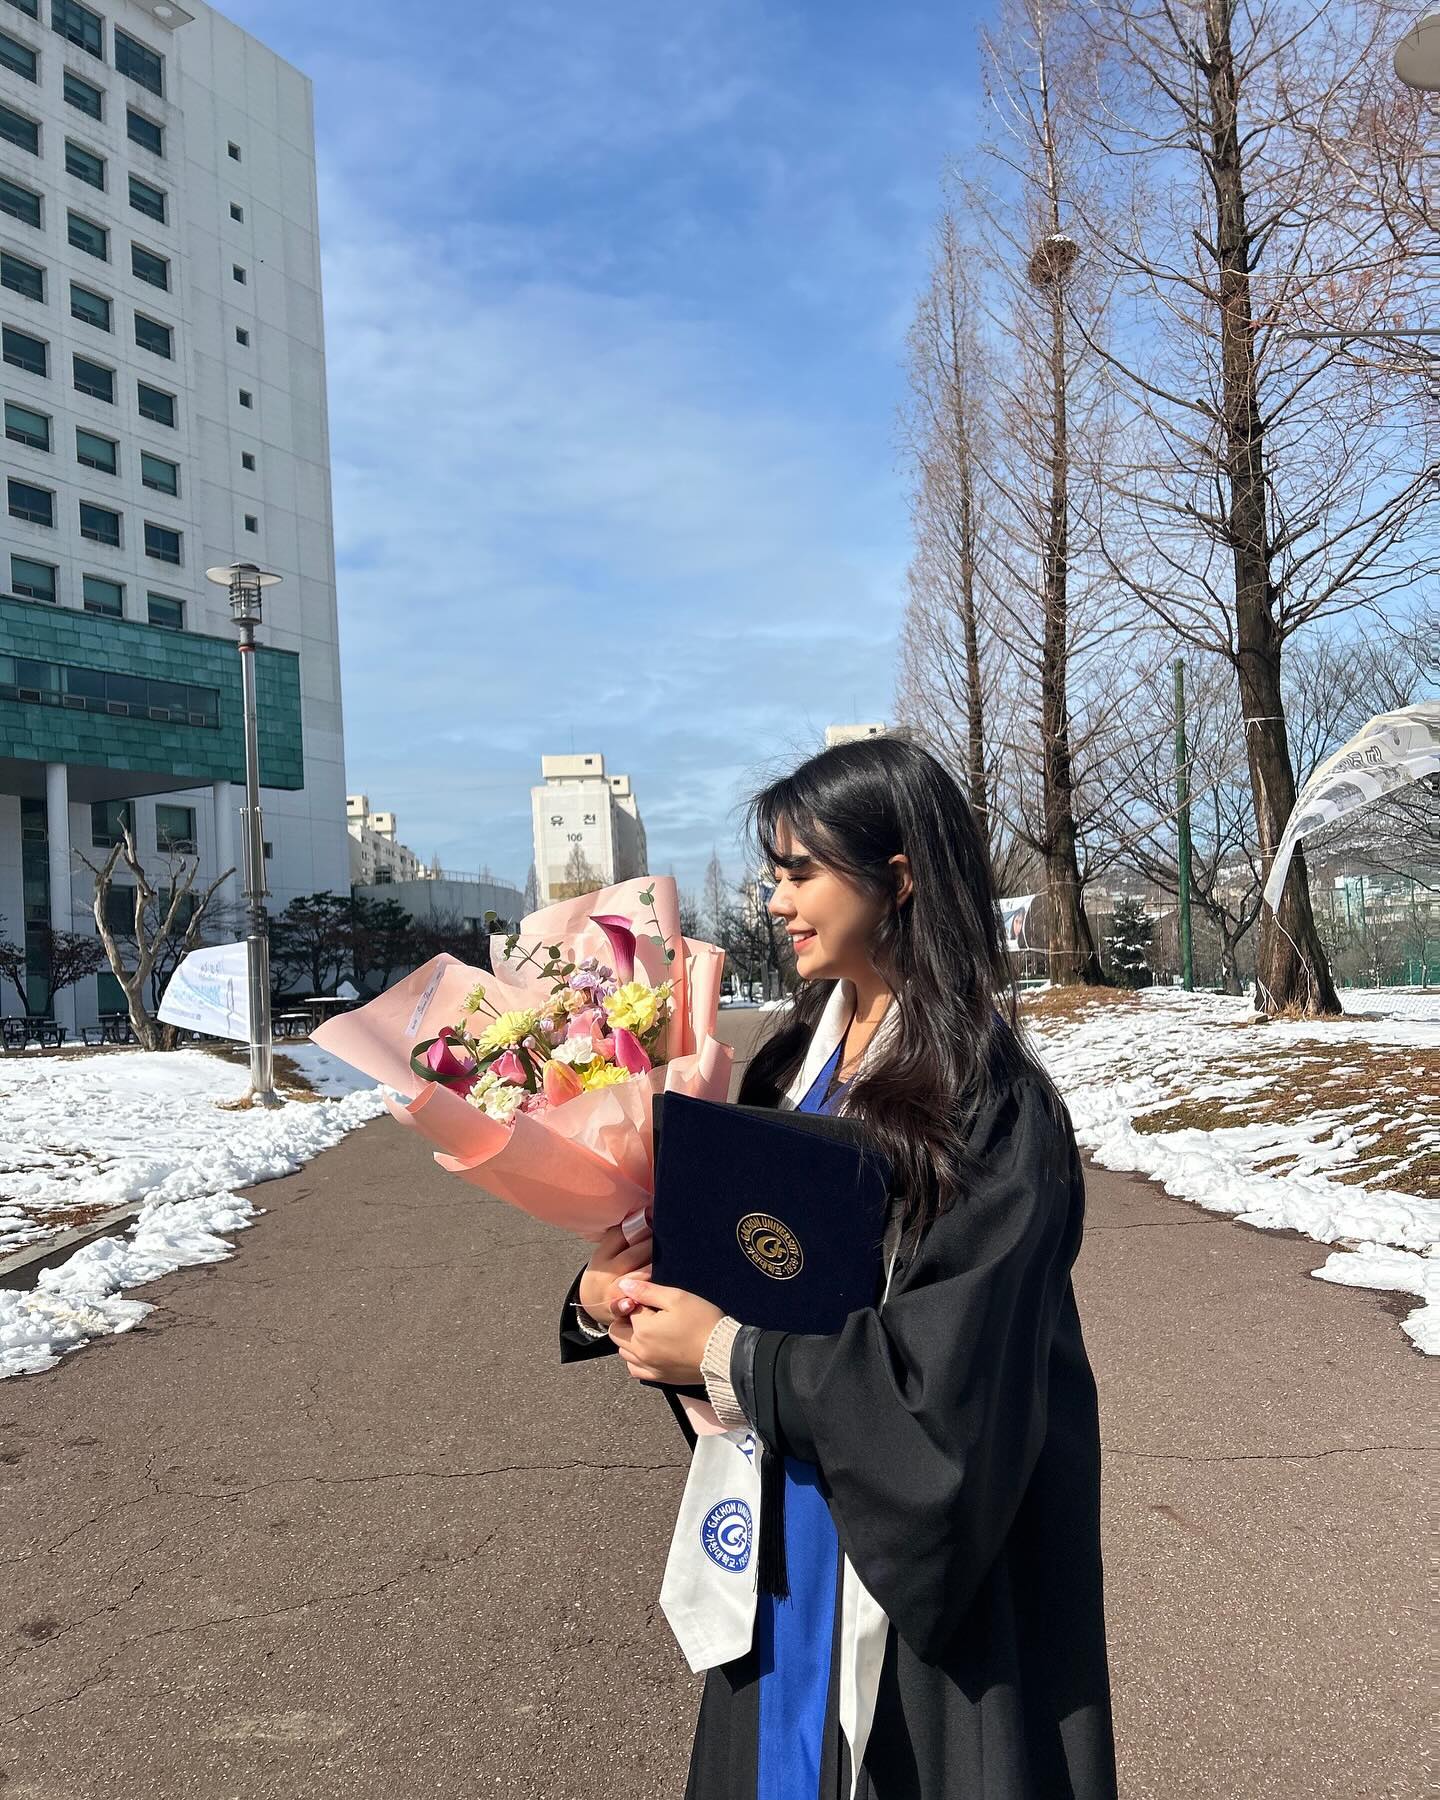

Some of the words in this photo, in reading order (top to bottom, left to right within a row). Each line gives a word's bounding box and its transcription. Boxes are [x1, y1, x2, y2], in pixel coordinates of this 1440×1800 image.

[567, 833, 583, 842] 106
[740, 1216, 763, 1241] GACHON
[761, 1216, 800, 1257] UNIVERSITY
[707, 1502, 737, 1529] GACHON
[705, 1533, 736, 1568] 가천대학교
